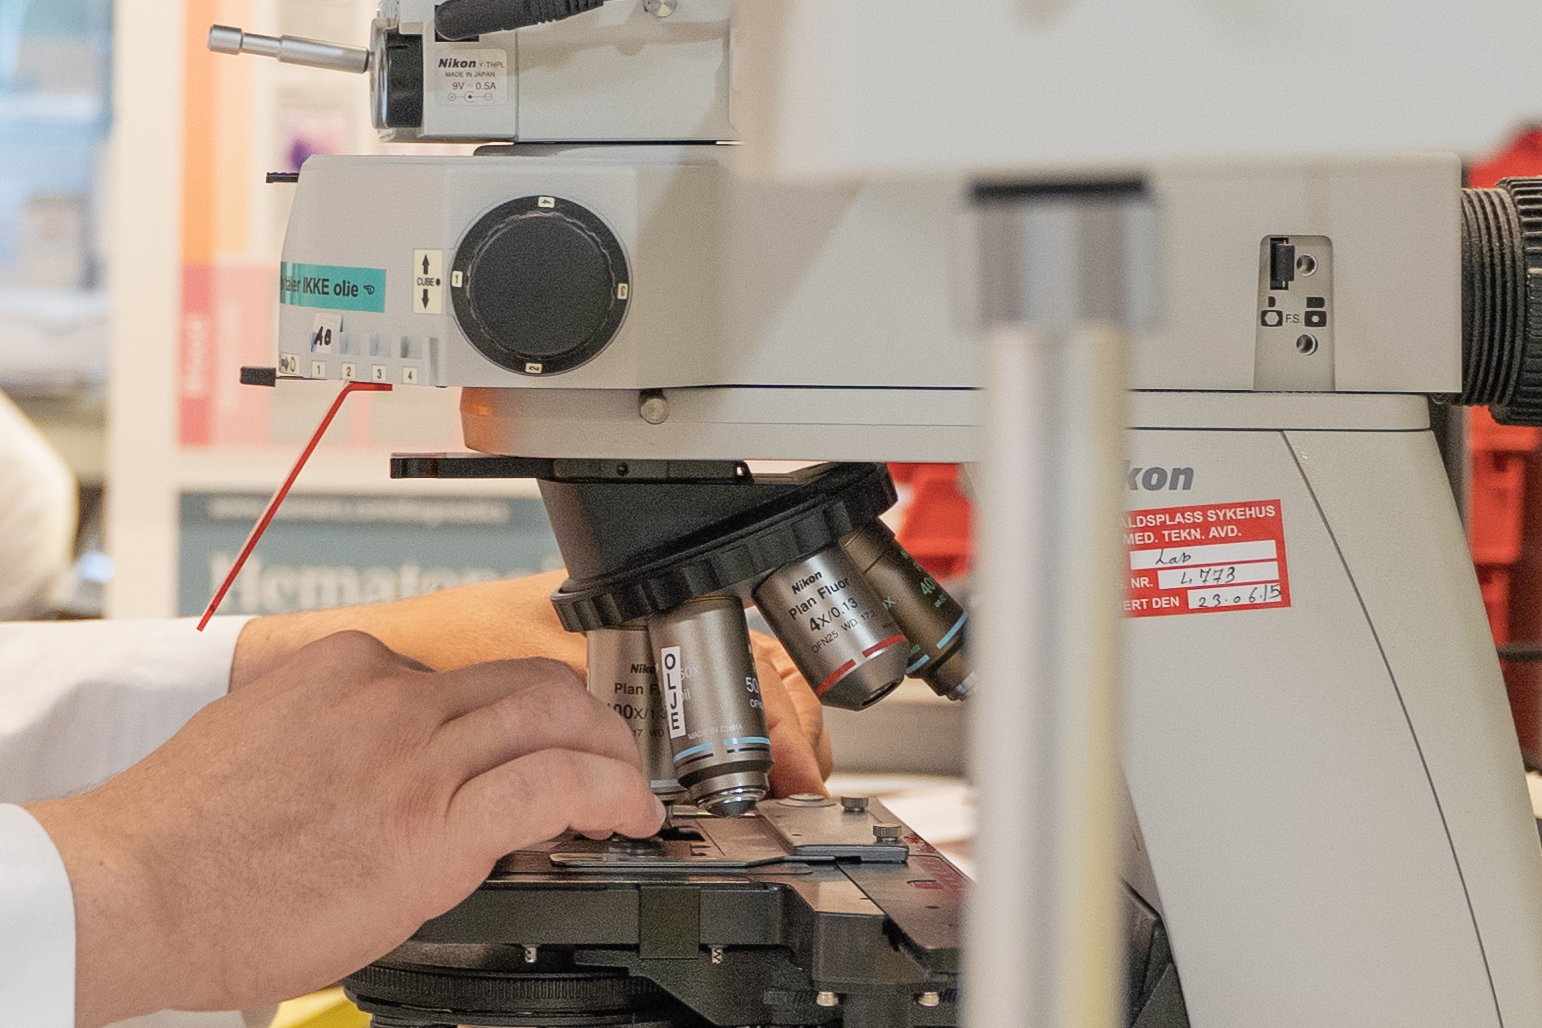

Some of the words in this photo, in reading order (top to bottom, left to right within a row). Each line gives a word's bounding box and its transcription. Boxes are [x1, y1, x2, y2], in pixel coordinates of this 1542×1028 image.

[438, 58, 477, 69] Nikon
[452, 81, 465, 90] 9V
[475, 81, 497, 90] 0.5A
[303, 277, 330, 296] IKKE
[333, 279, 359, 297] olje
[416, 277, 435, 287] CUBE
[1285, 314, 1302, 324] F.S.
[345, 366, 352, 377] 2
[376, 368, 383, 379] 3
[407, 370, 414, 380] 4
[1123, 460, 1195, 491] kon
[1207, 505, 1276, 522] SYKEHUS
[1162, 528, 1206, 542] TEKN.
[1208, 525, 1243, 539] AVD.
[791, 571, 823, 595] Nikon
[1130, 576, 1154, 588] NR.
[788, 597, 817, 620] Plan
[816, 577, 850, 600] Fluor
[1123, 599, 1149, 611] ERT
[1151, 596, 1180, 609] DEN
[614, 682, 644, 695] Plan
